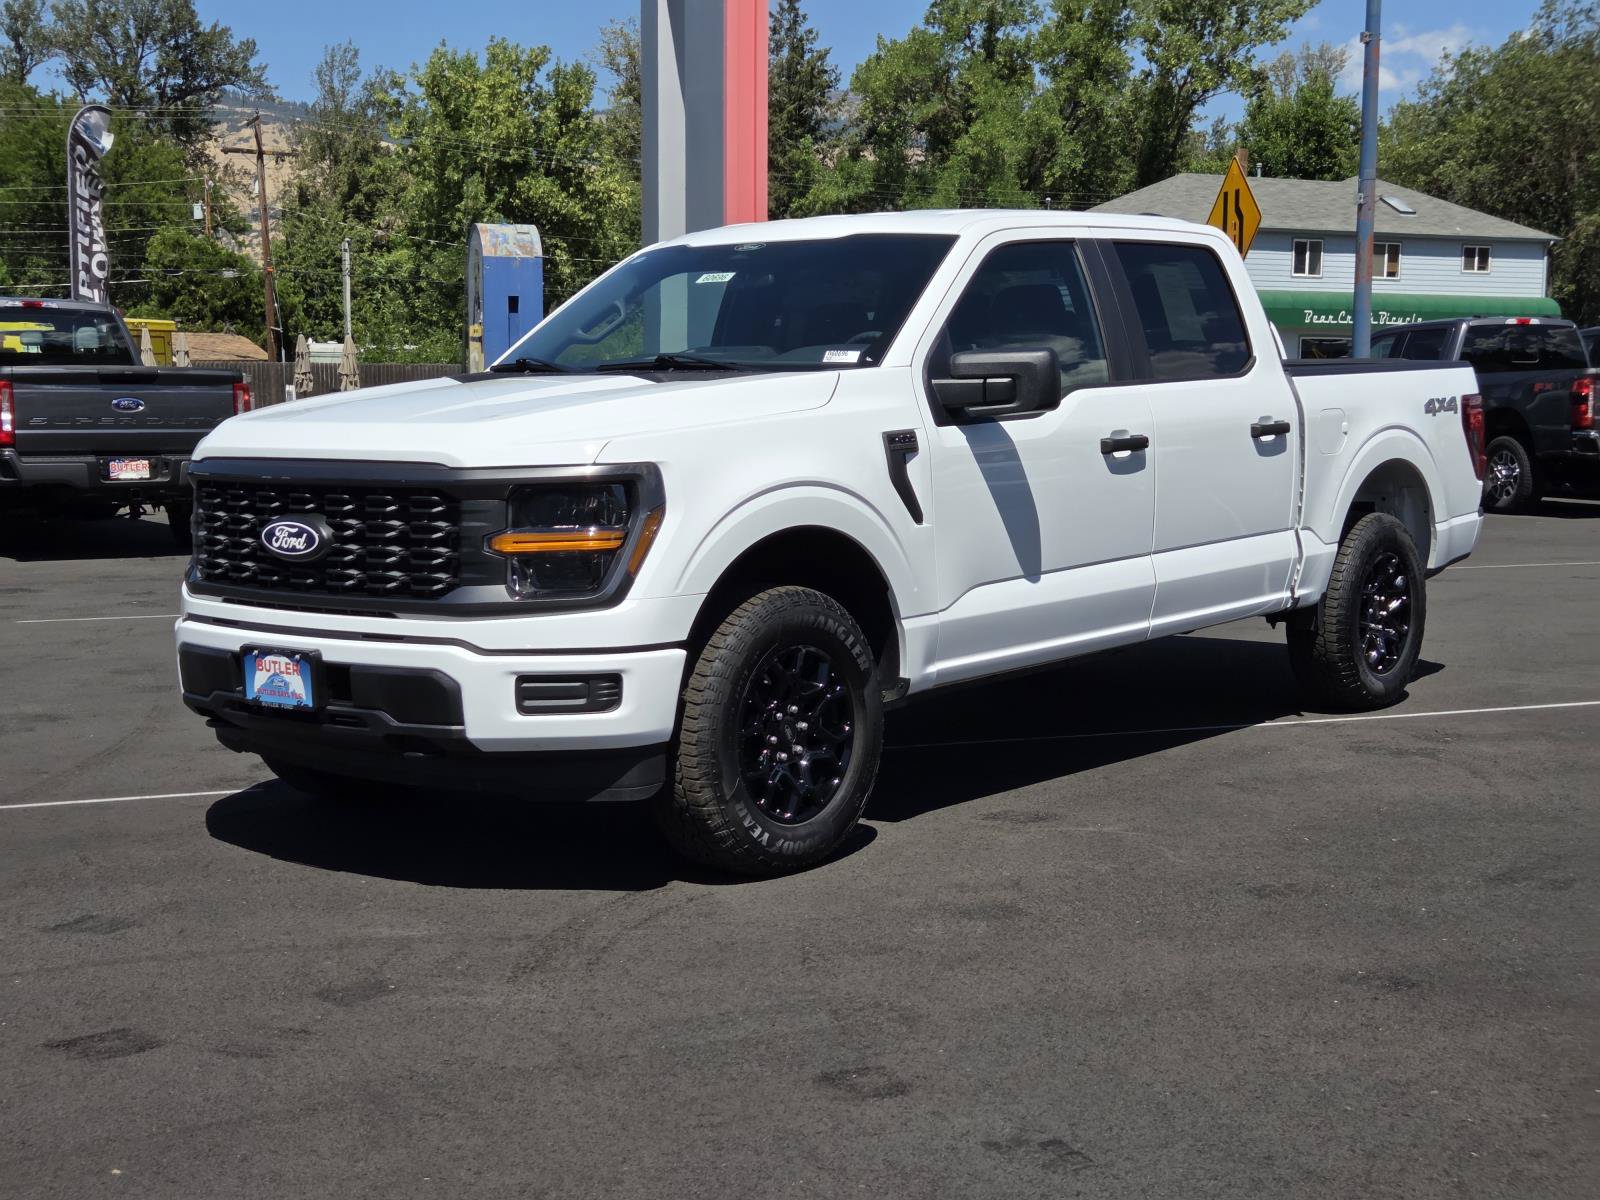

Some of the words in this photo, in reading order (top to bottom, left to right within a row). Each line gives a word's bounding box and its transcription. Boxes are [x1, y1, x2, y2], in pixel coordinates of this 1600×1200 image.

[1304, 310, 1337, 324] Bear
[1424, 396, 1458, 416] 4X4
[29, 417, 137, 425] SUPER
[110, 463, 149, 472] BUTLER
[272, 526, 307, 549] Ford
[256, 658, 302, 676] BUTLER
